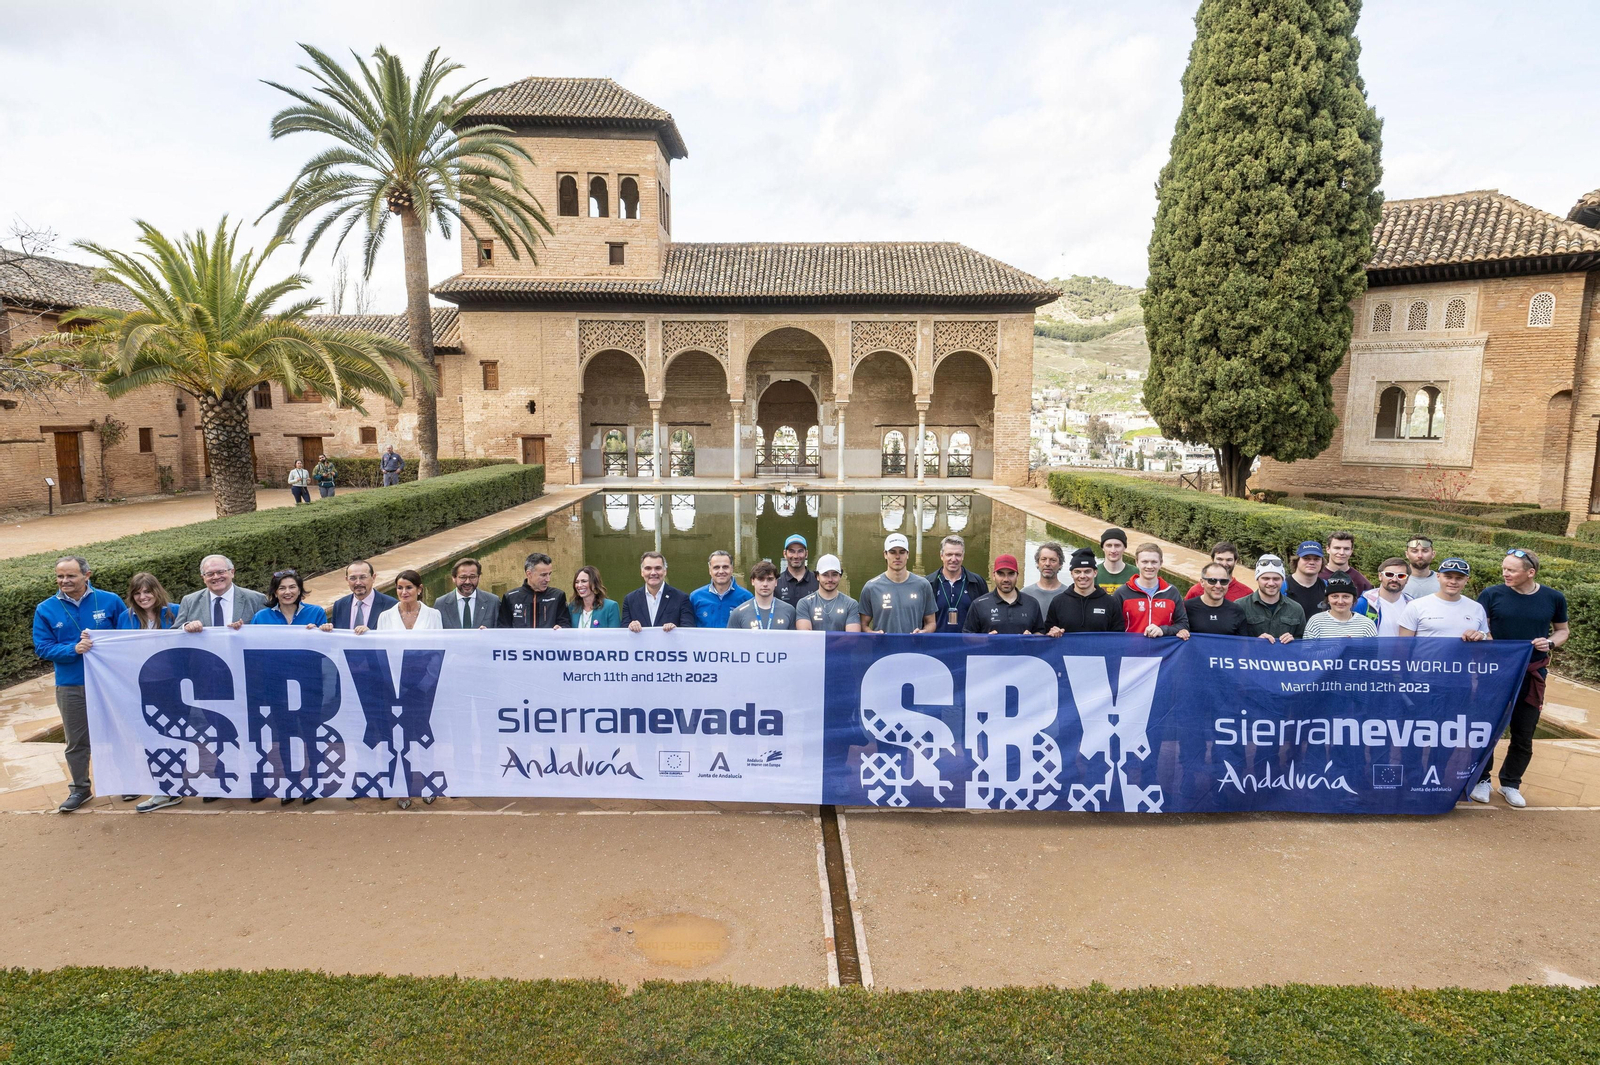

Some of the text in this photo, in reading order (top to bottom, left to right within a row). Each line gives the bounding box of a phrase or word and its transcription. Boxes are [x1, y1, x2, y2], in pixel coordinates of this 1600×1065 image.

[492, 649, 788, 664] FIS SNOWBOARD CROSS WORLD CUP
[1209, 656, 1500, 675] FIS SNOWBOARD CROSS WORLD CUP
[562, 671, 718, 683] March 11th and 12th 2023
[1280, 681, 1431, 693] March 11th and 12th 2023
[138, 647, 449, 799] SBX
[498, 699, 784, 737] sierranevada
[860, 652, 1165, 814] SBX
[1214, 709, 1493, 749] sierranevada
[500, 746, 645, 781] Andalucía
[1217, 759, 1359, 796] Andalucía
